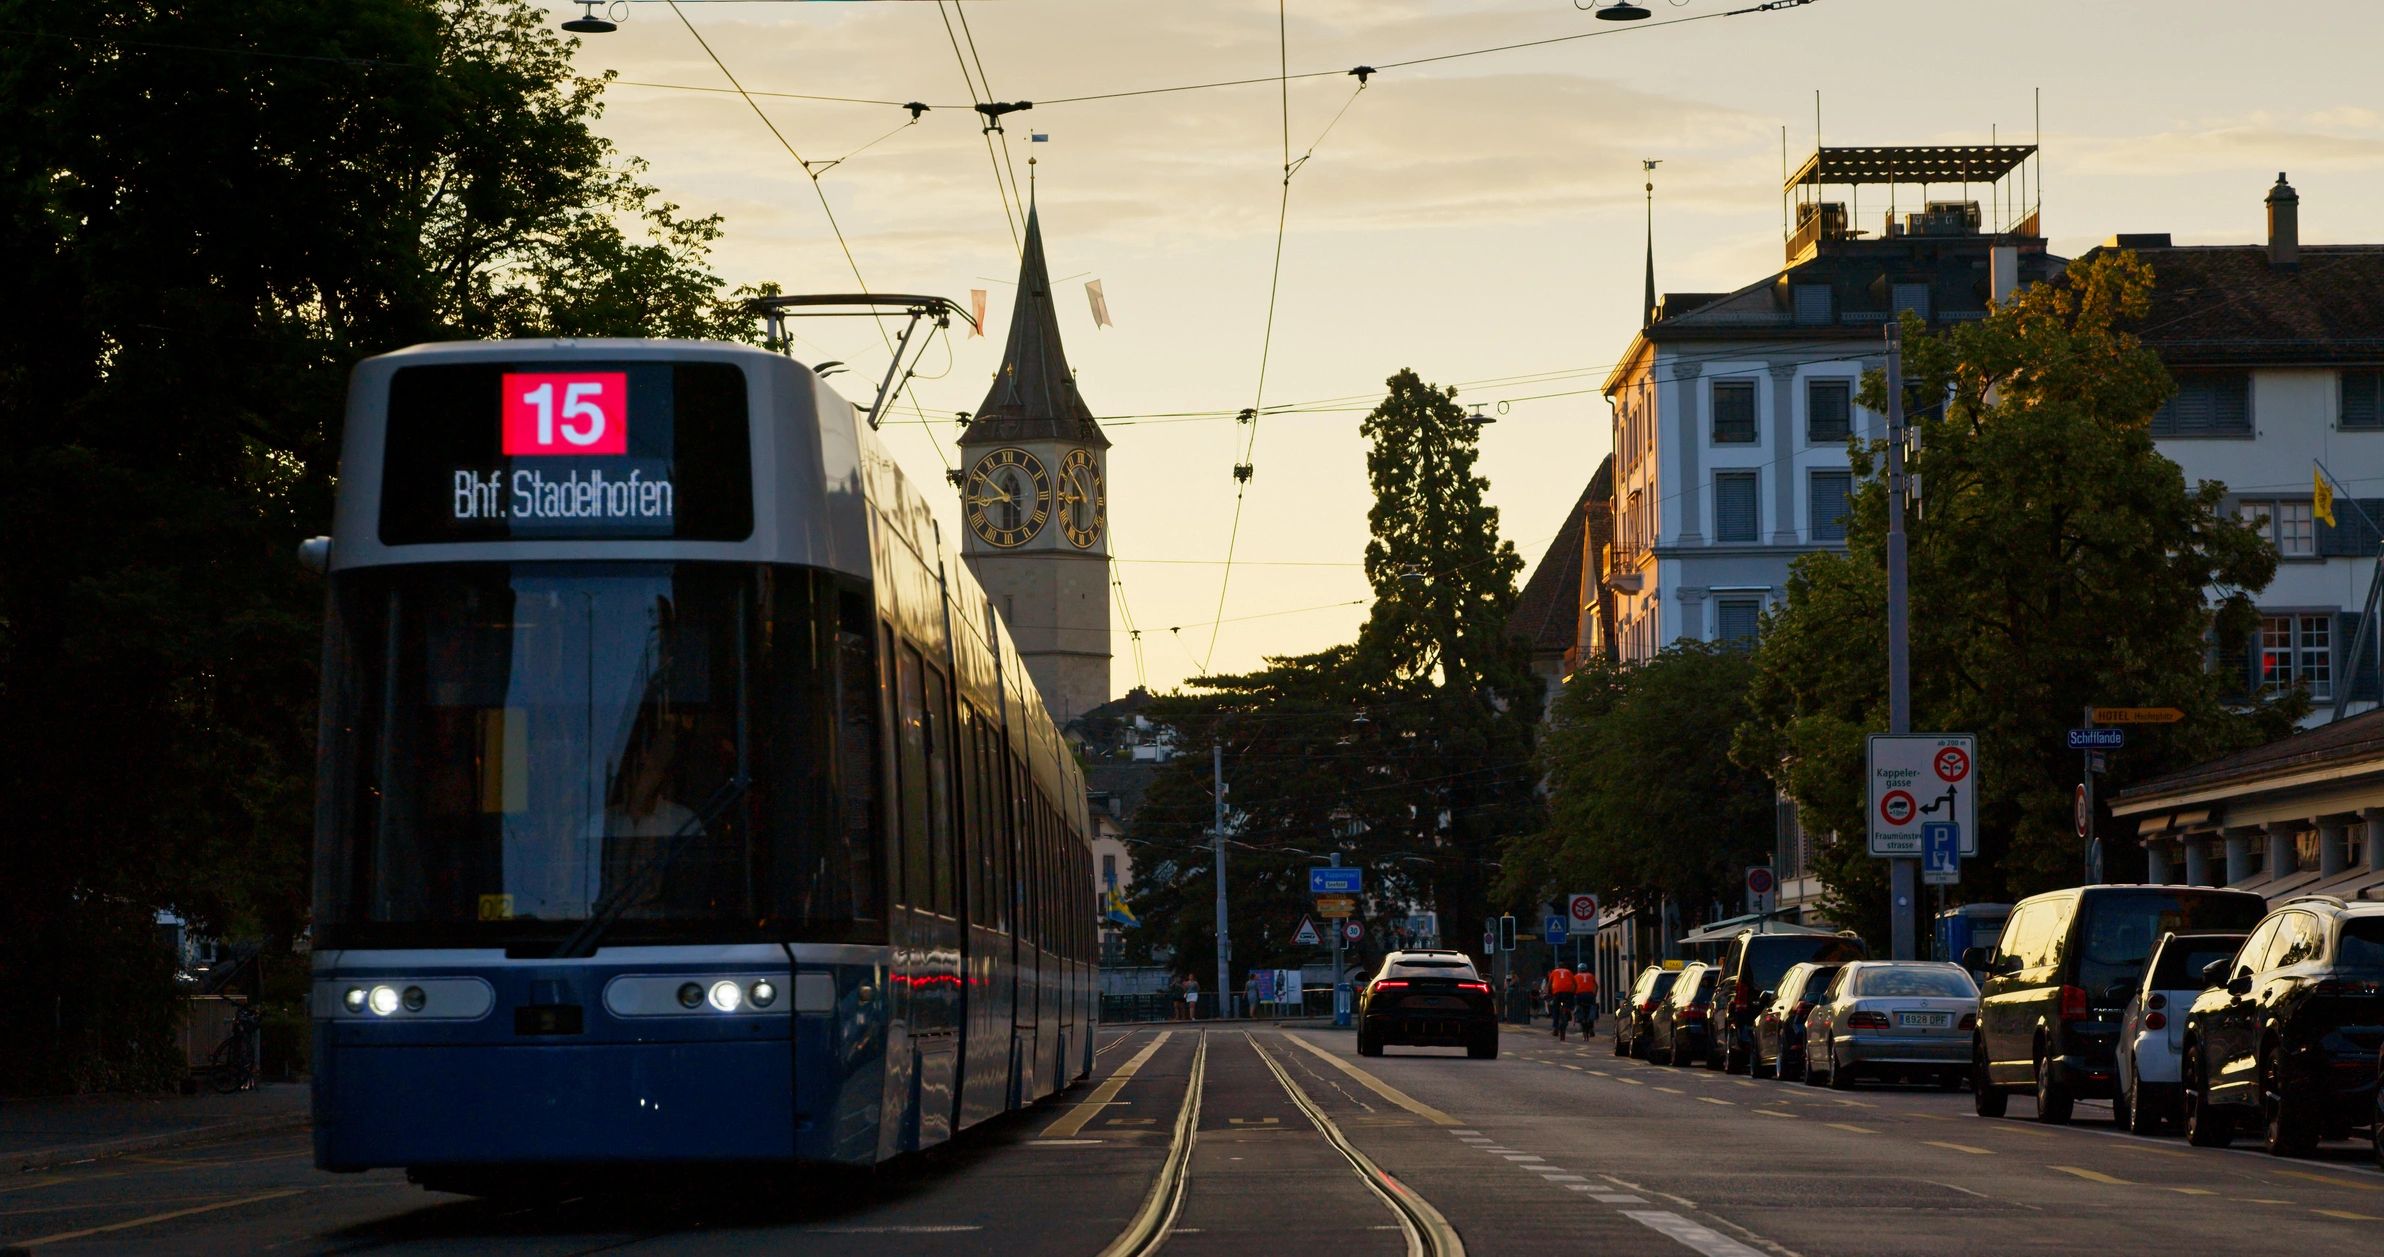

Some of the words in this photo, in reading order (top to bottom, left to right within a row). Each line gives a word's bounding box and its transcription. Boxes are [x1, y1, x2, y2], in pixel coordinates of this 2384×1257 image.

[523, 382, 605, 446] 15
[1002, 452, 1014, 463] XII
[454, 470, 506, 519] Bhf.
[512, 468, 672, 519] Stadelhofen
[2098, 711, 2129, 721] HOTEL
[1877, 768, 1920, 780] Kappeler-
[1886, 779, 1912, 789] gasse
[1349, 927, 1358, 935] 30
[1905, 1015, 1927, 1024] 8928
